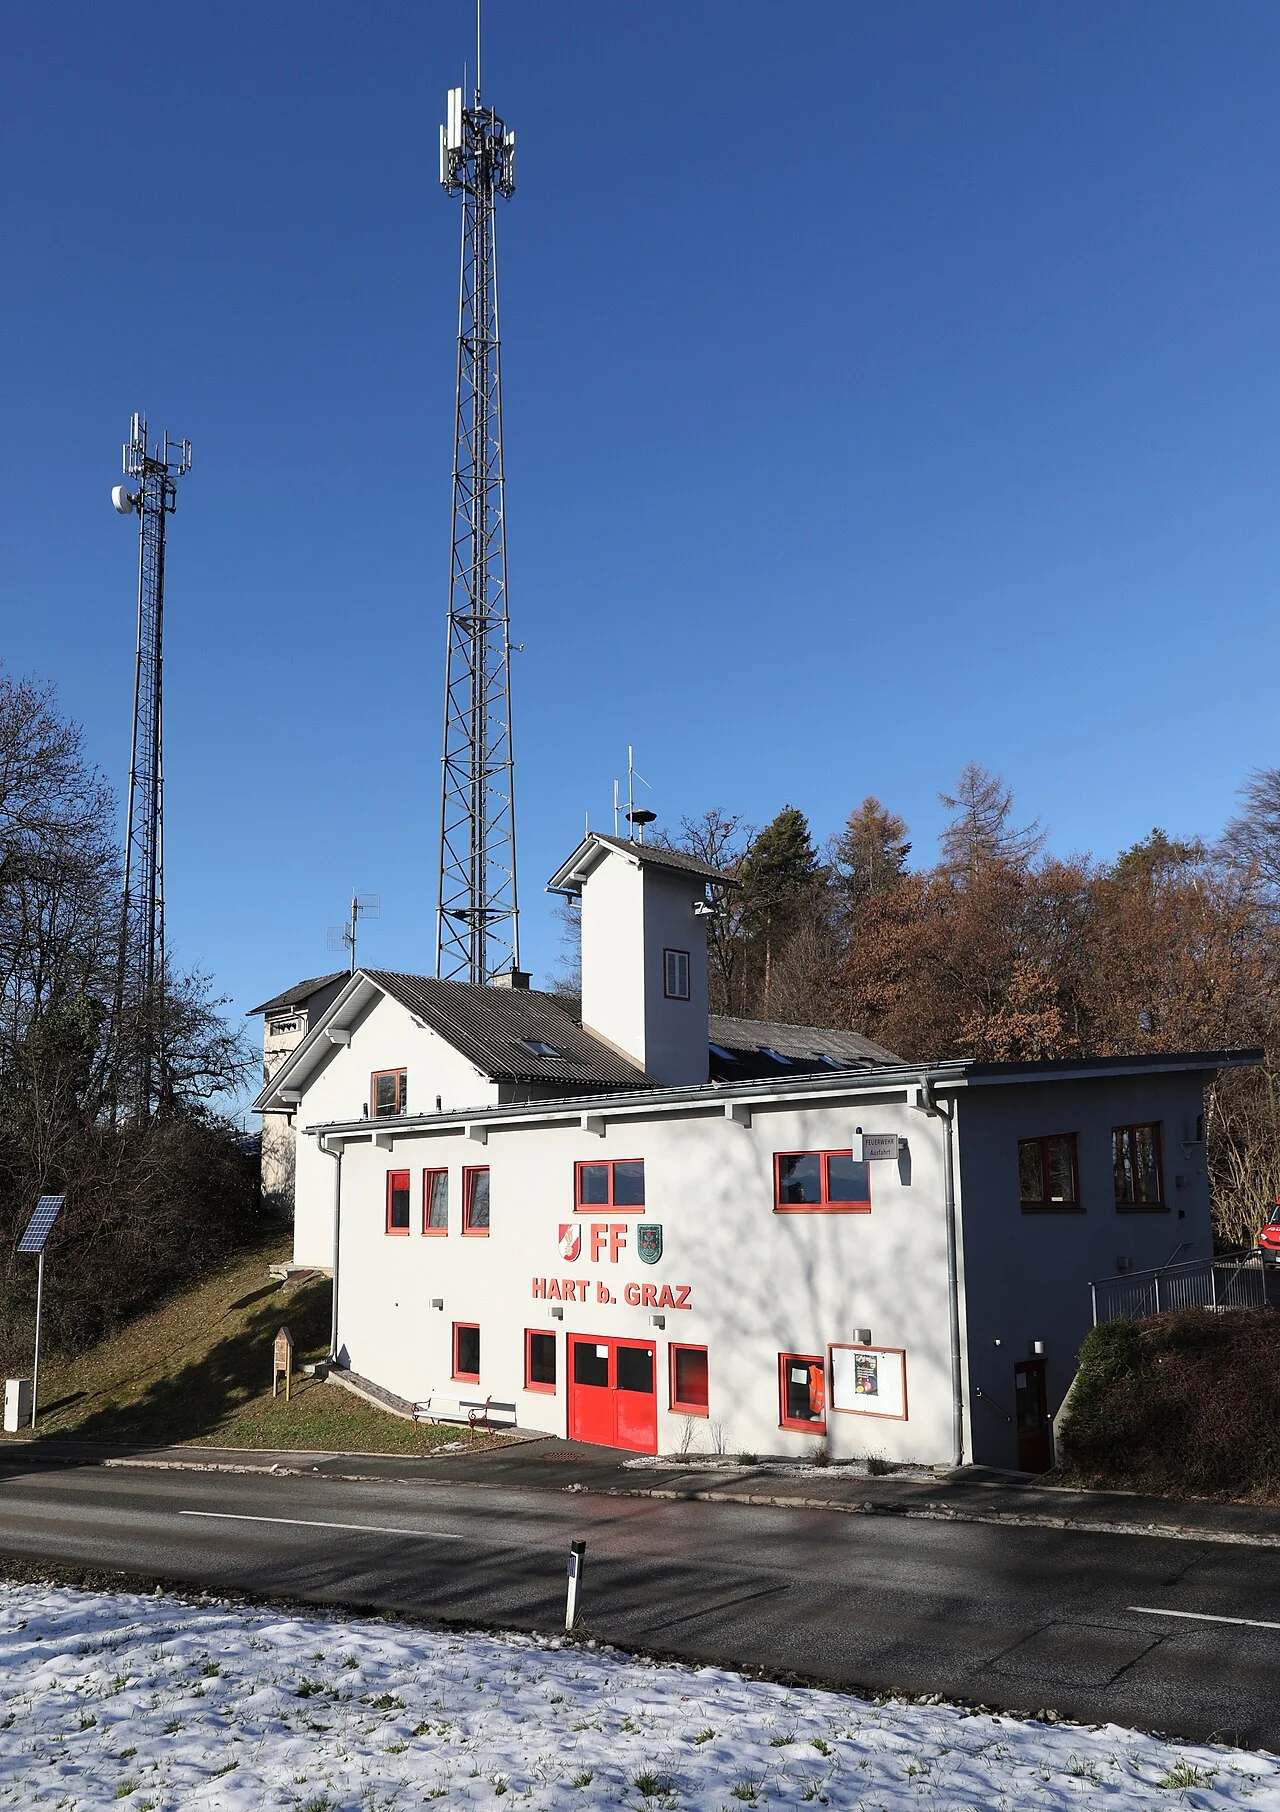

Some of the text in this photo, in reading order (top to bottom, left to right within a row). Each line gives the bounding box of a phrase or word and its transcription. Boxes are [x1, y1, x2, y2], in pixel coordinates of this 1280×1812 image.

[591, 1224, 628, 1263] FF
[532, 1278, 692, 1309] HART b. GRAZ
